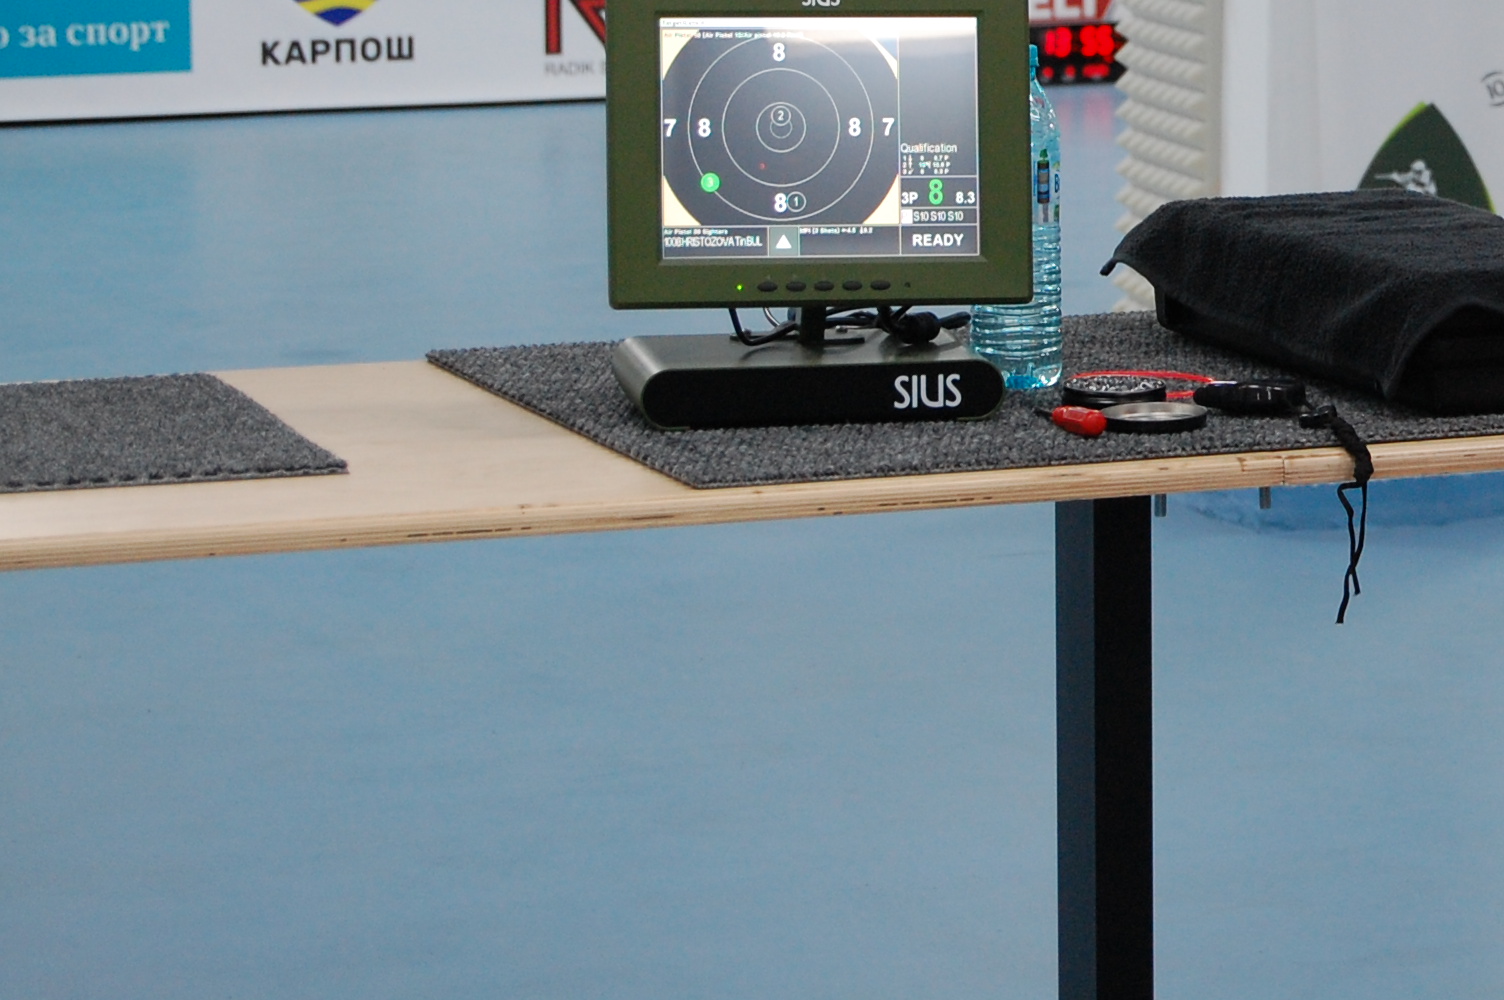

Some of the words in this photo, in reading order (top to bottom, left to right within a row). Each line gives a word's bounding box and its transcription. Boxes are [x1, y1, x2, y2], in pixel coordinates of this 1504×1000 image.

[18, 23, 58, 49] за
[65, 19, 171, 52] спорт
[260, 35, 416, 67] КАРПОШ
[772, 42, 786, 62] 8
[663, 118, 677, 138] 7
[697, 117, 712, 138] 8
[847, 117, 862, 137] 8
[881, 117, 895, 136] 7
[900, 142, 958, 155] Qualification
[928, 178, 944, 206] 8
[955, 190, 976, 205] 8.3
[774, 193, 787, 213] 8
[912, 233, 964, 247] READY
[893, 373, 962, 409] SIUS
